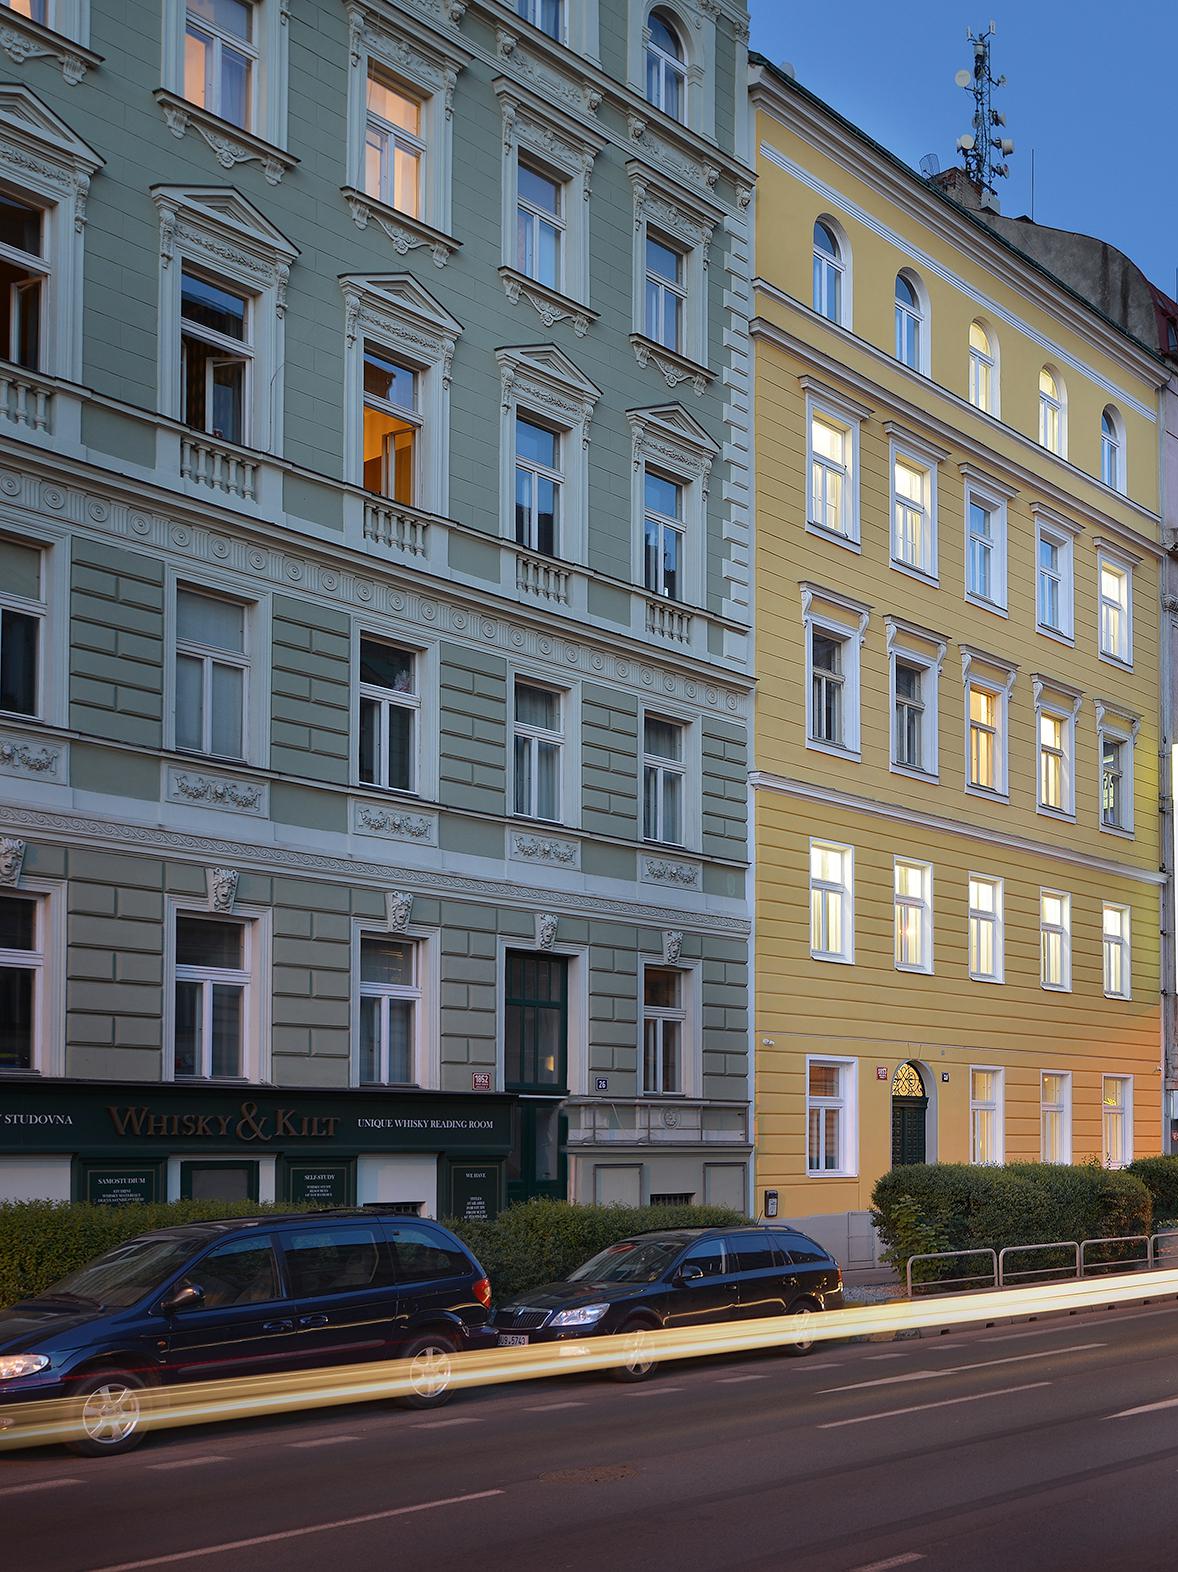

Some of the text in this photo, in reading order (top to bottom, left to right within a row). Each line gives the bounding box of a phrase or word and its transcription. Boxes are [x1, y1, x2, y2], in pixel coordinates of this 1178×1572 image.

[4, 1113, 73, 1125] STUDOVNA
[235, 1101, 273, 1141] &
[357, 1118, 494, 1129] UNIQUE WHISKY READING ROOM
[97, 1177, 146, 1185] SAMOSTUDIUM
